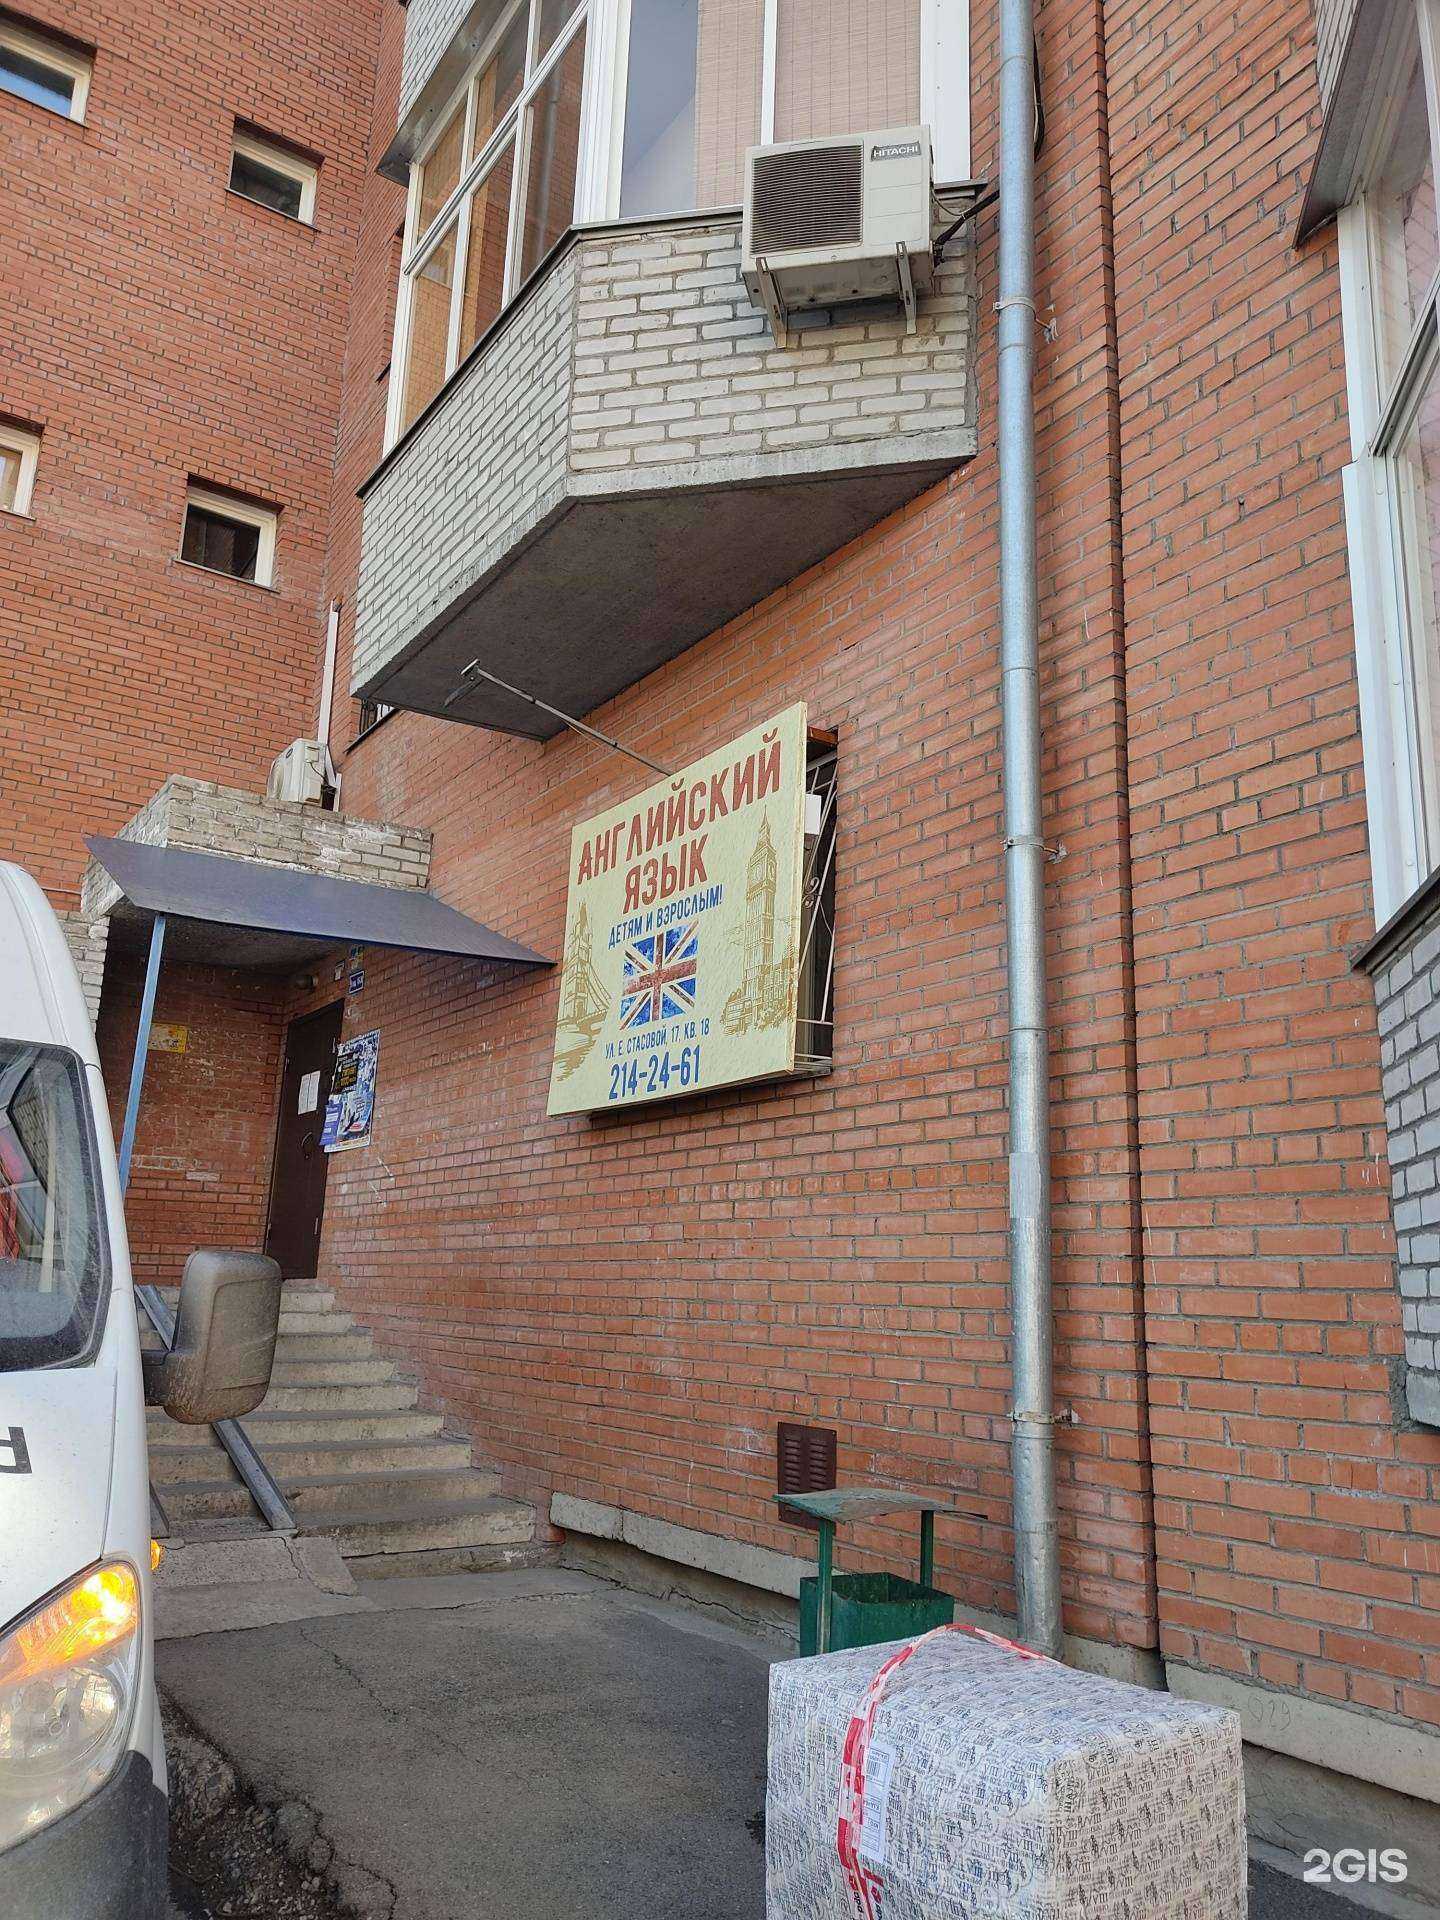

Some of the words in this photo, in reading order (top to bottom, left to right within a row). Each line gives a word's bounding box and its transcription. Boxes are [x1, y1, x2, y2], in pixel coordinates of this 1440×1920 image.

[873, 145, 918, 157] HITACHI
[577, 727, 782, 885] АНГЛИЙСКИЙ
[623, 833, 708, 914] ЯЗЫК
[608, 915, 643, 950] ДЕТЯМ
[645, 911, 653, 932] И
[656, 884, 723, 928] ВЗРОСЛЫМ!
[684, 1021, 697, 1041] КВ.
[701, 1018, 710, 1036] 18
[608, 1044, 700, 1100] 214-24-61
